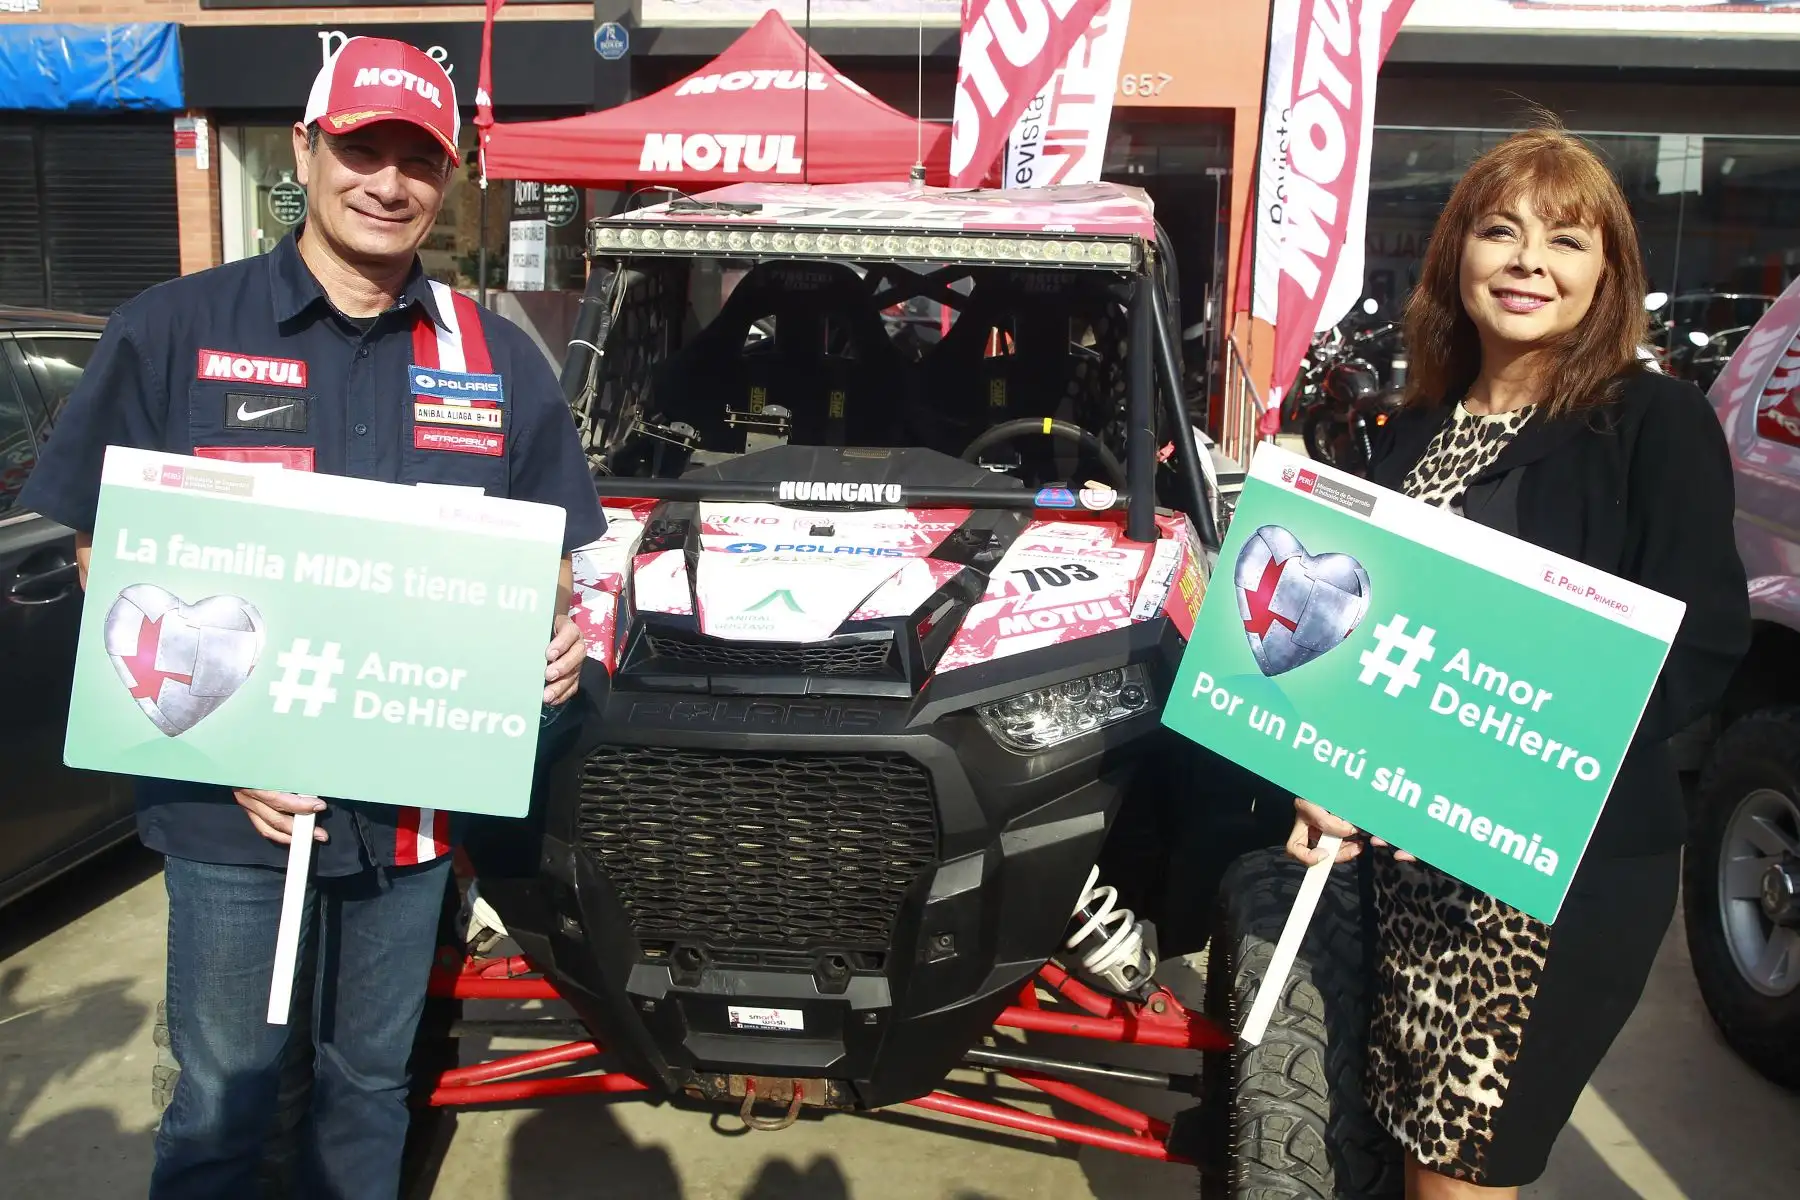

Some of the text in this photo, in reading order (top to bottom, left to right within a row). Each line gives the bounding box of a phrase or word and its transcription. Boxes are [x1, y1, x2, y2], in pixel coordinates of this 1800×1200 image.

[354, 67, 443, 109] MOTUL
[674, 69, 829, 96] MOTUL
[638, 132, 803, 174] MOTUL
[1014, 93, 1045, 190] evista
[204, 354, 302, 384] MOTUL
[438, 379, 499, 391] POLARIS
[447, 410, 472, 421] ALIAGA
[779, 481, 902, 502] HUANCAYO
[1298, 475, 1314, 486] PERÚ
[774, 543, 903, 557] POLARIS
[115, 529, 539, 612] La familia MIDIS tiene un
[1010, 563, 1099, 592] 703
[998, 599, 1123, 636] MOTUL
[358, 651, 468, 692] Amor
[1443, 648, 1554, 714] Amor
[353, 689, 527, 739] DeHierro
[628, 701, 882, 729] POLARIS
[1429, 683, 1602, 783] DeHierro
[1191, 671, 1561, 878] Por un Perú sin anemia
